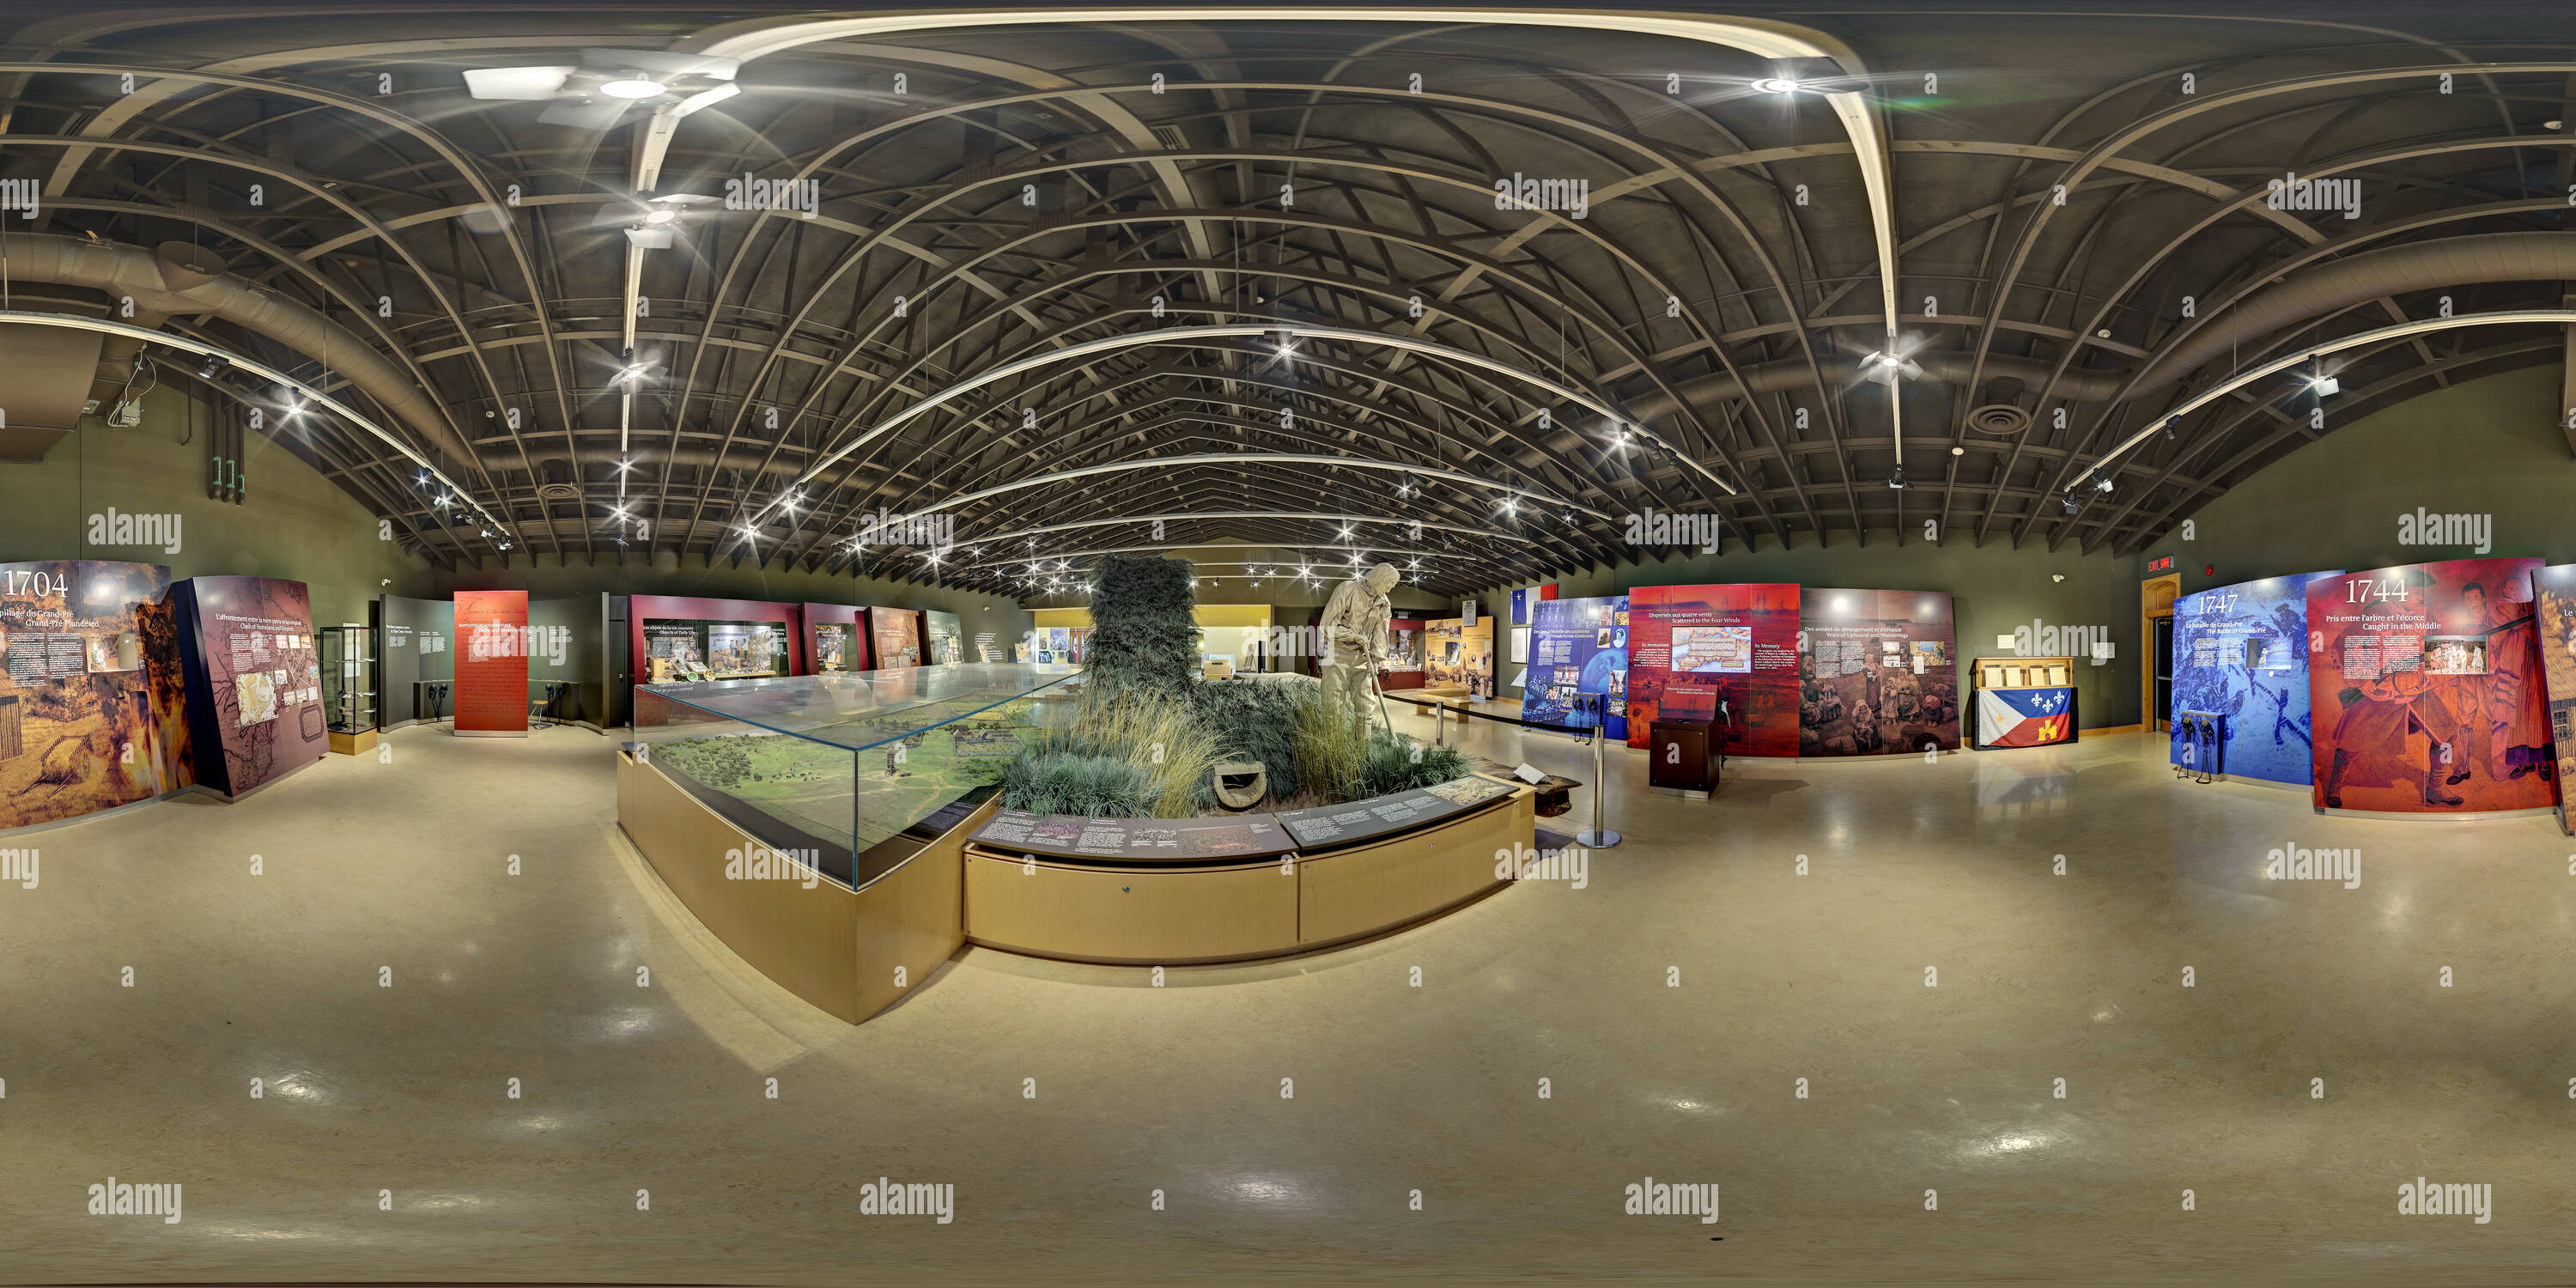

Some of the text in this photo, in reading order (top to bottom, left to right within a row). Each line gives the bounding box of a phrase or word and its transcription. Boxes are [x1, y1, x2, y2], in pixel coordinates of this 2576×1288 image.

[3, 570, 68, 597] 1704
[2346, 579, 2409, 603] 1744
[0, 609, 24, 618] pillage
[2198, 594, 2238, 614] 1747
[2363, 623, 2389, 631] Caught
